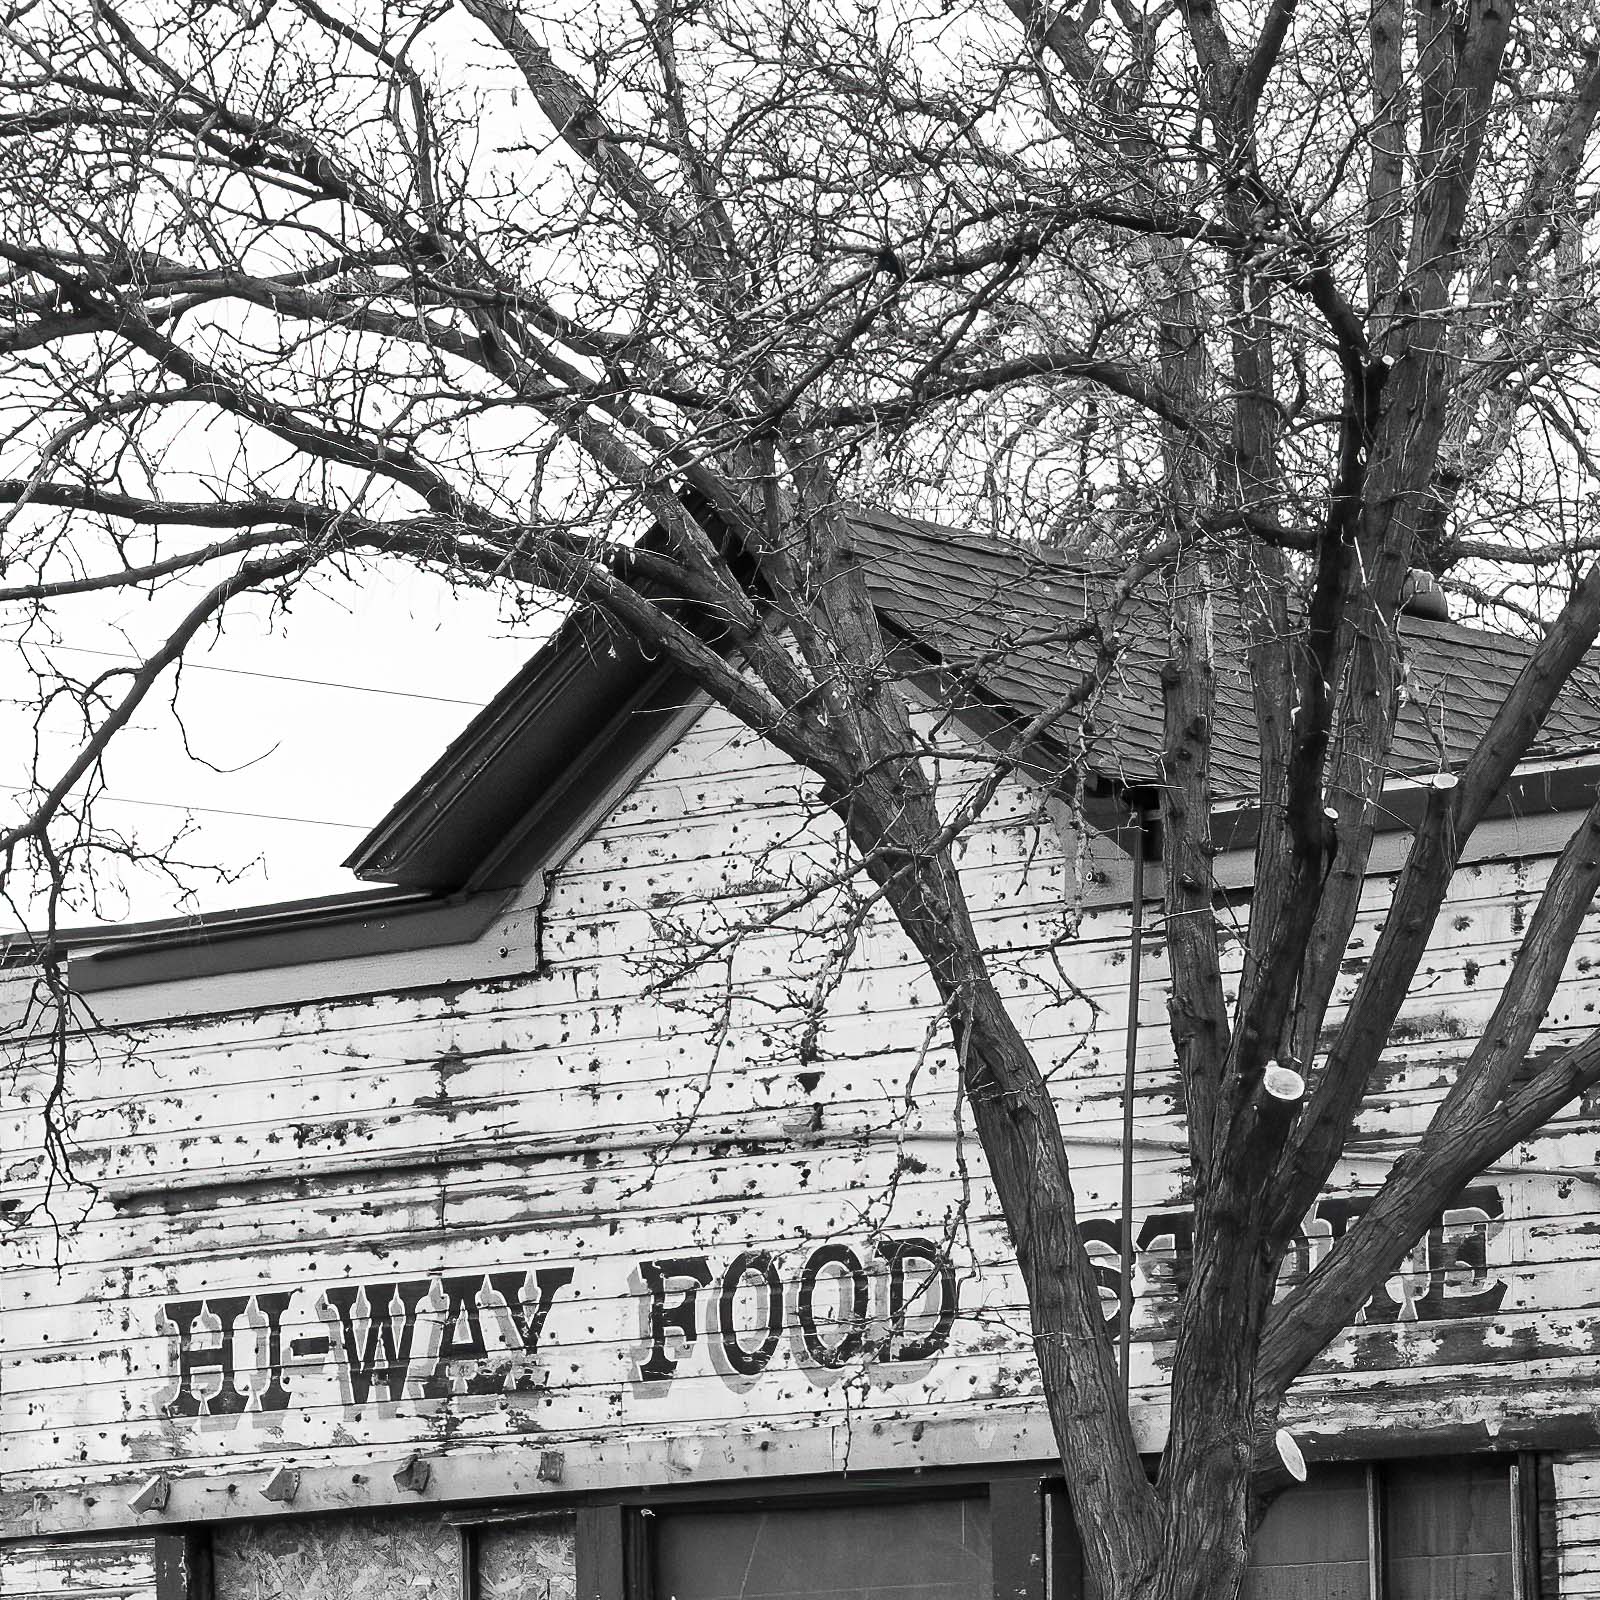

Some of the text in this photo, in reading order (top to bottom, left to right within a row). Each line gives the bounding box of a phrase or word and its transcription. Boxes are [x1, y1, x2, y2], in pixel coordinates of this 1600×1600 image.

[160, 1185, 1508, 1418] HI-WAY FOOD STE
